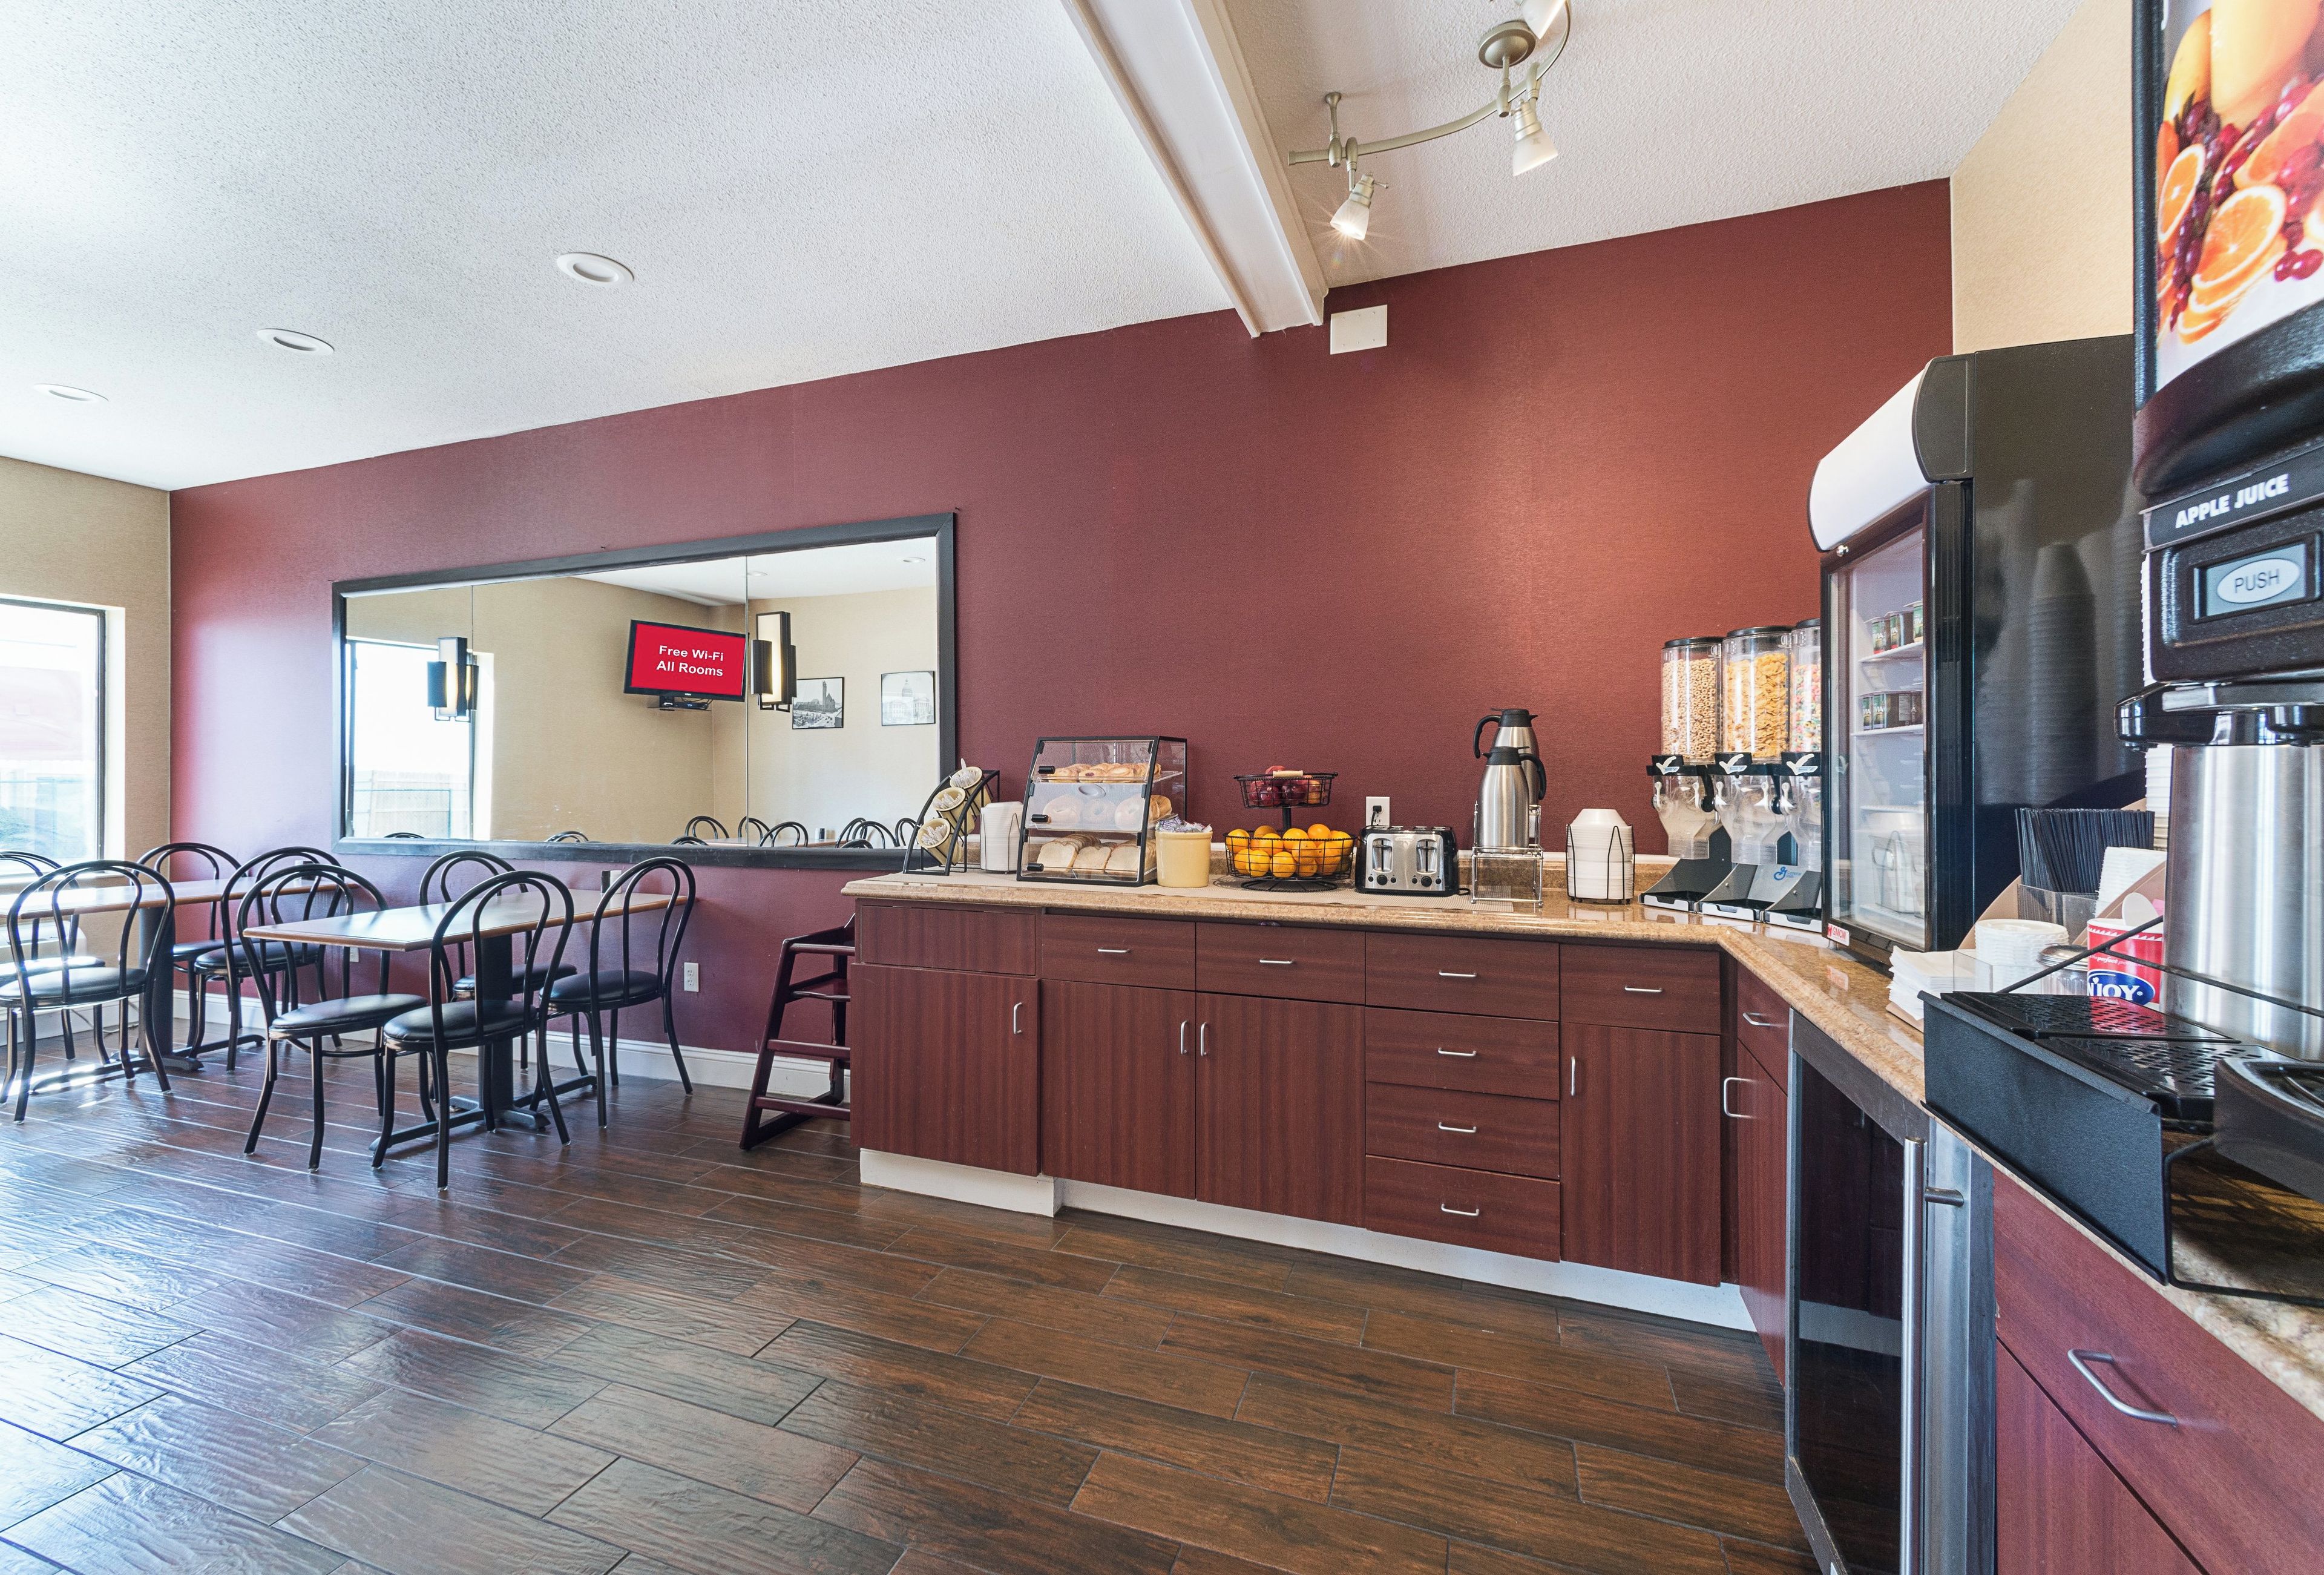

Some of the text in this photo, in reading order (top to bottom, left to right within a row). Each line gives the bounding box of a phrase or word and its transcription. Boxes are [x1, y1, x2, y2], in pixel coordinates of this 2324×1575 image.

[2175, 473, 2290, 528] APPLE JUICE
[2234, 568, 2280, 594] PUSH
[659, 645, 724, 662] Free Wi-Fi
[656, 660, 724, 677] All Rooms
